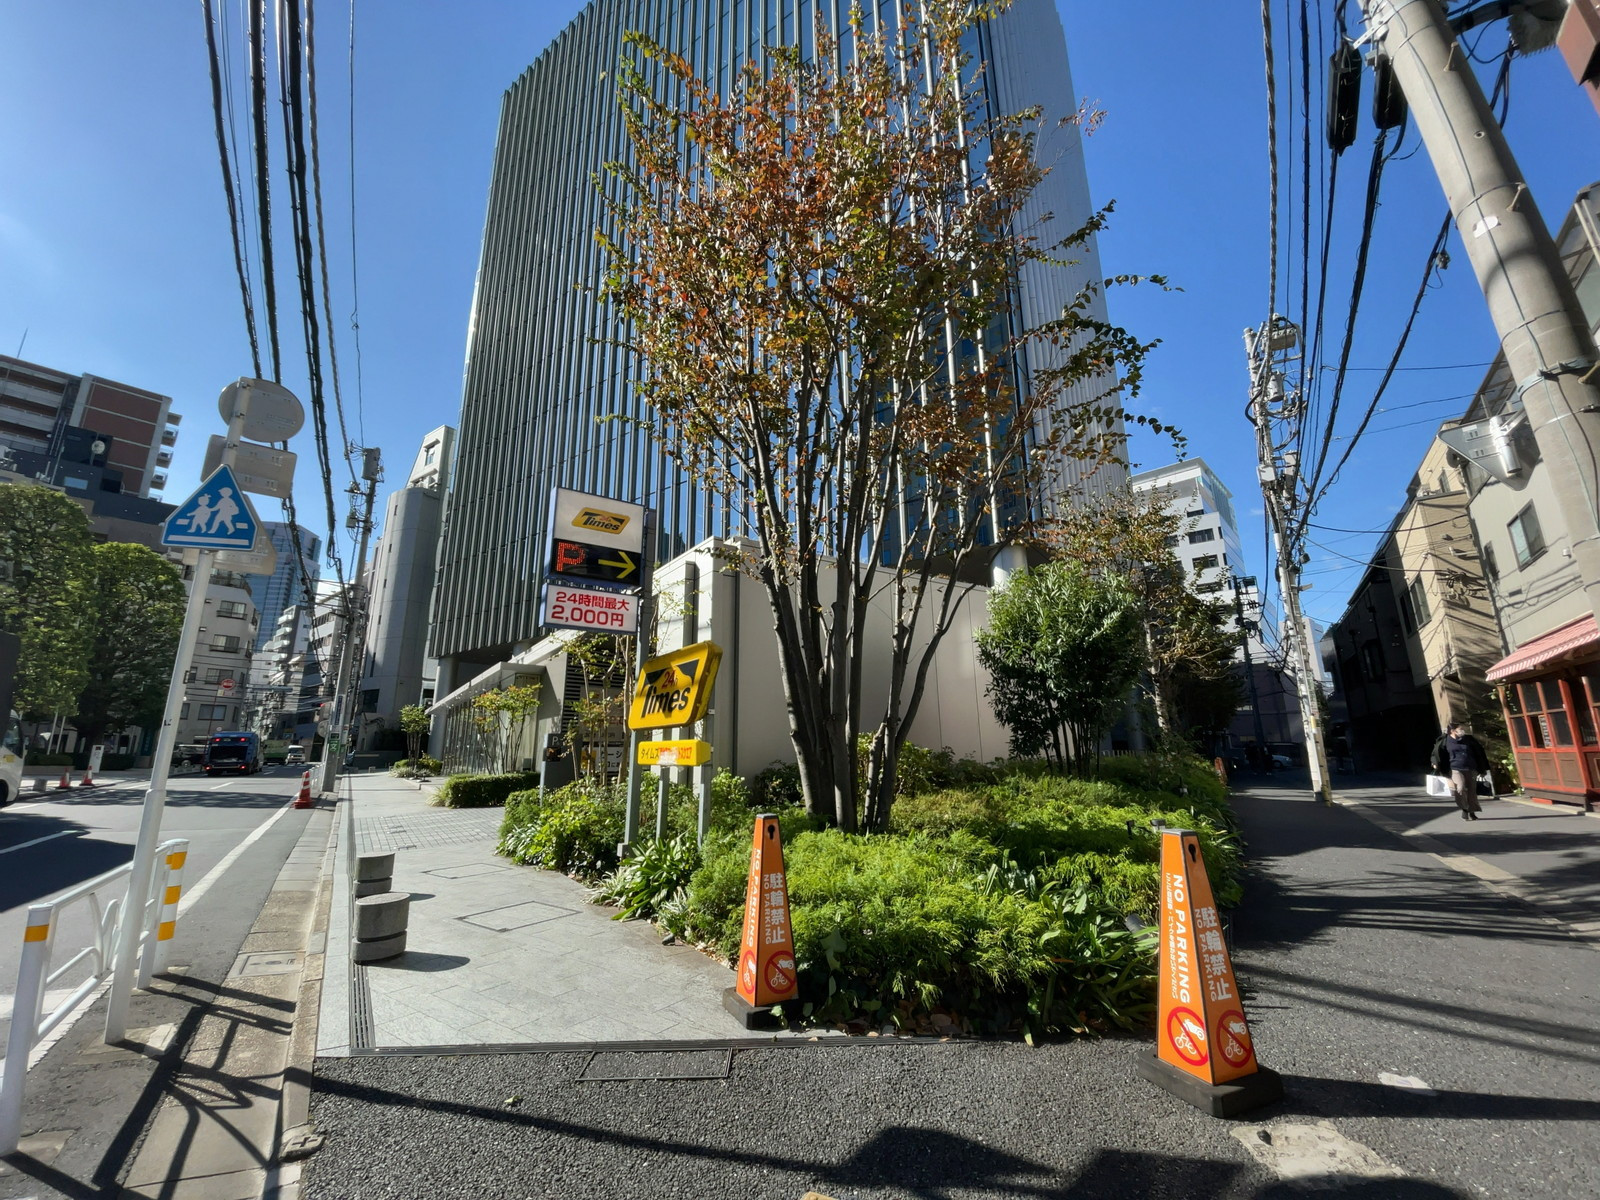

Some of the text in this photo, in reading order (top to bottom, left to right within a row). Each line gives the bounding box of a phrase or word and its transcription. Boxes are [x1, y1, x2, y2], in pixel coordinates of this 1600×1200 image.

[582, 514, 620, 531] Times
[556, 542, 585, 572] P
[551, 604, 624, 627] 2,000円
[556, 591, 630, 612] 24時間最大
[640, 684, 691, 719] Times
[763, 874, 772, 945] NO PARKING
[770, 872, 786, 944] 駐輪禁止
[1173, 874, 1190, 1004] NO PARKING
[1195, 908, 1217, 1002] NO PARKING
[1201, 906, 1232, 1000] 駐輪禁止
